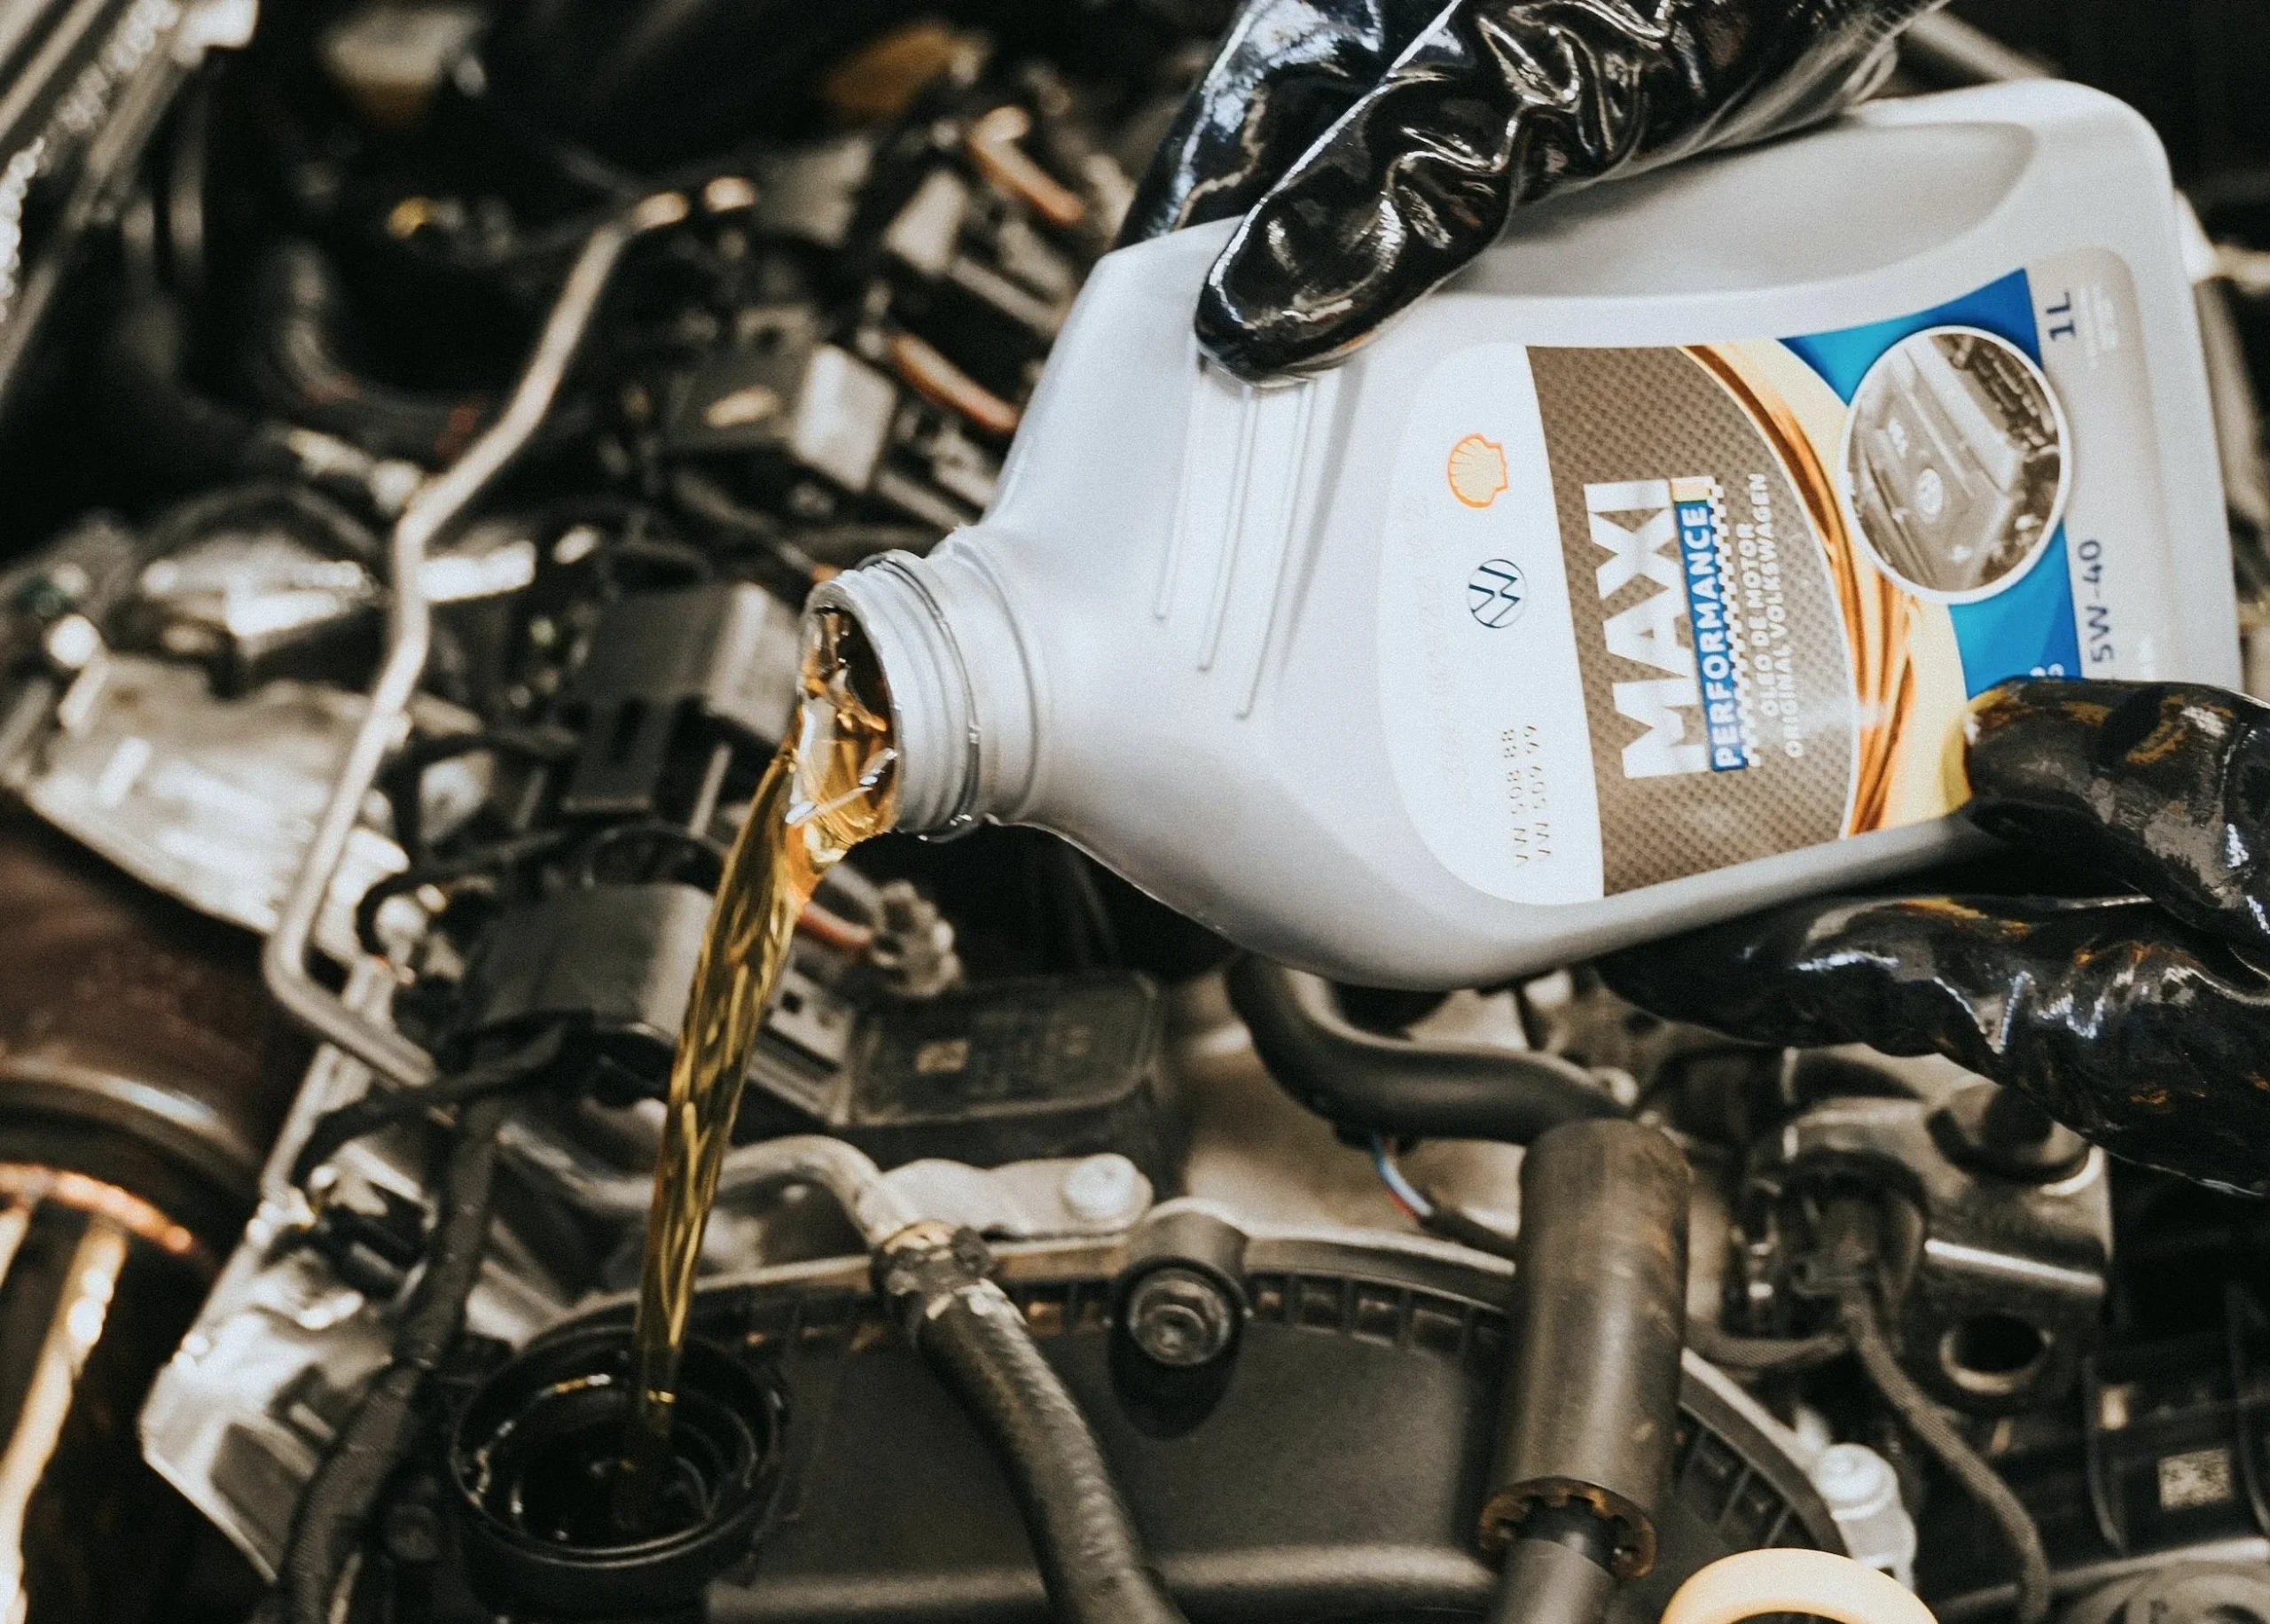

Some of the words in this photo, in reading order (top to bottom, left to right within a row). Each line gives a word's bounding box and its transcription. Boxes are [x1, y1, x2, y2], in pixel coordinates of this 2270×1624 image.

[2046, 291, 2077, 341] 1L
[1735, 522, 1765, 609] MOTOR
[1747, 472, 1789, 639] VOLKSWAGEN
[2077, 539, 2115, 663] 5W-40
[1584, 479, 1710, 779] MAXI
[1681, 506, 1742, 769] PERFORMANCE
[1748, 615, 1771, 647] DE
[1773, 644, 1804, 758] ORIGINAL
[1513, 827, 1530, 868] VW
[1534, 821, 1552, 863] VW
